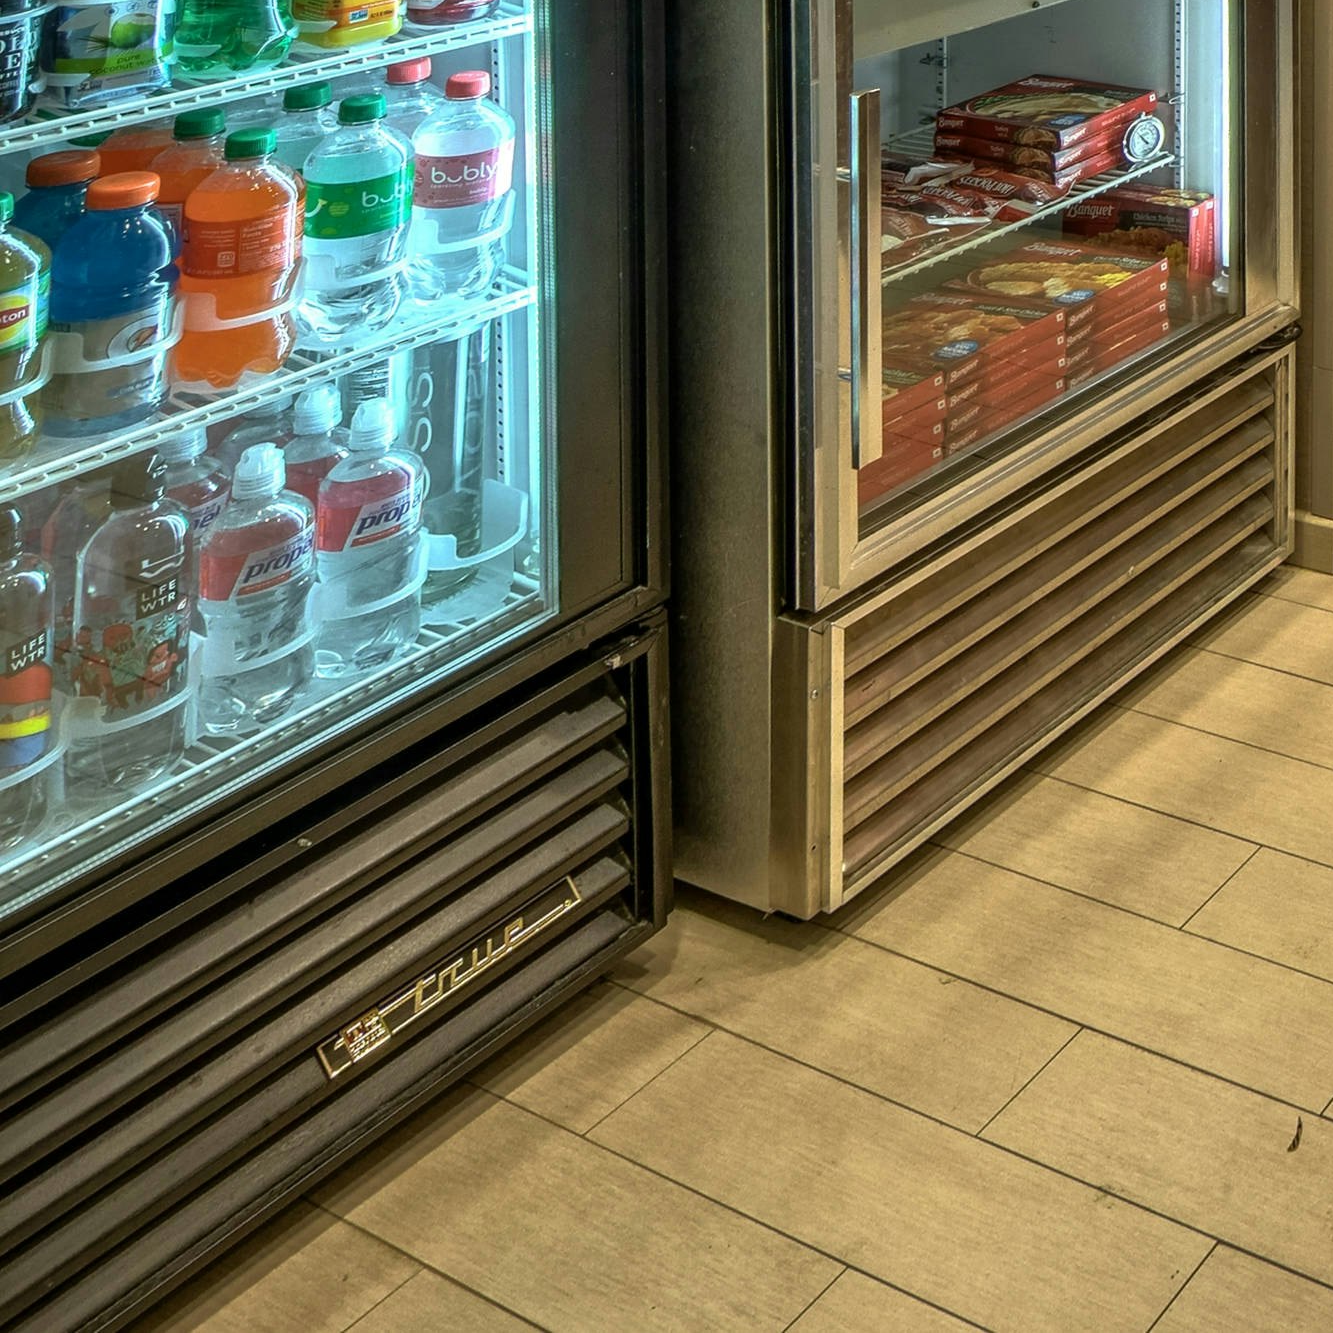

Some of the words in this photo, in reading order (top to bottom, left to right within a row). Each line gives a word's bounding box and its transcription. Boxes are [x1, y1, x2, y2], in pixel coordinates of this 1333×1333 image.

[140, 591, 177, 613] WTR
[141, 577, 177, 602] LIFE
[11, 632, 46, 659] LIFE
[11, 646, 46, 671] WTR
